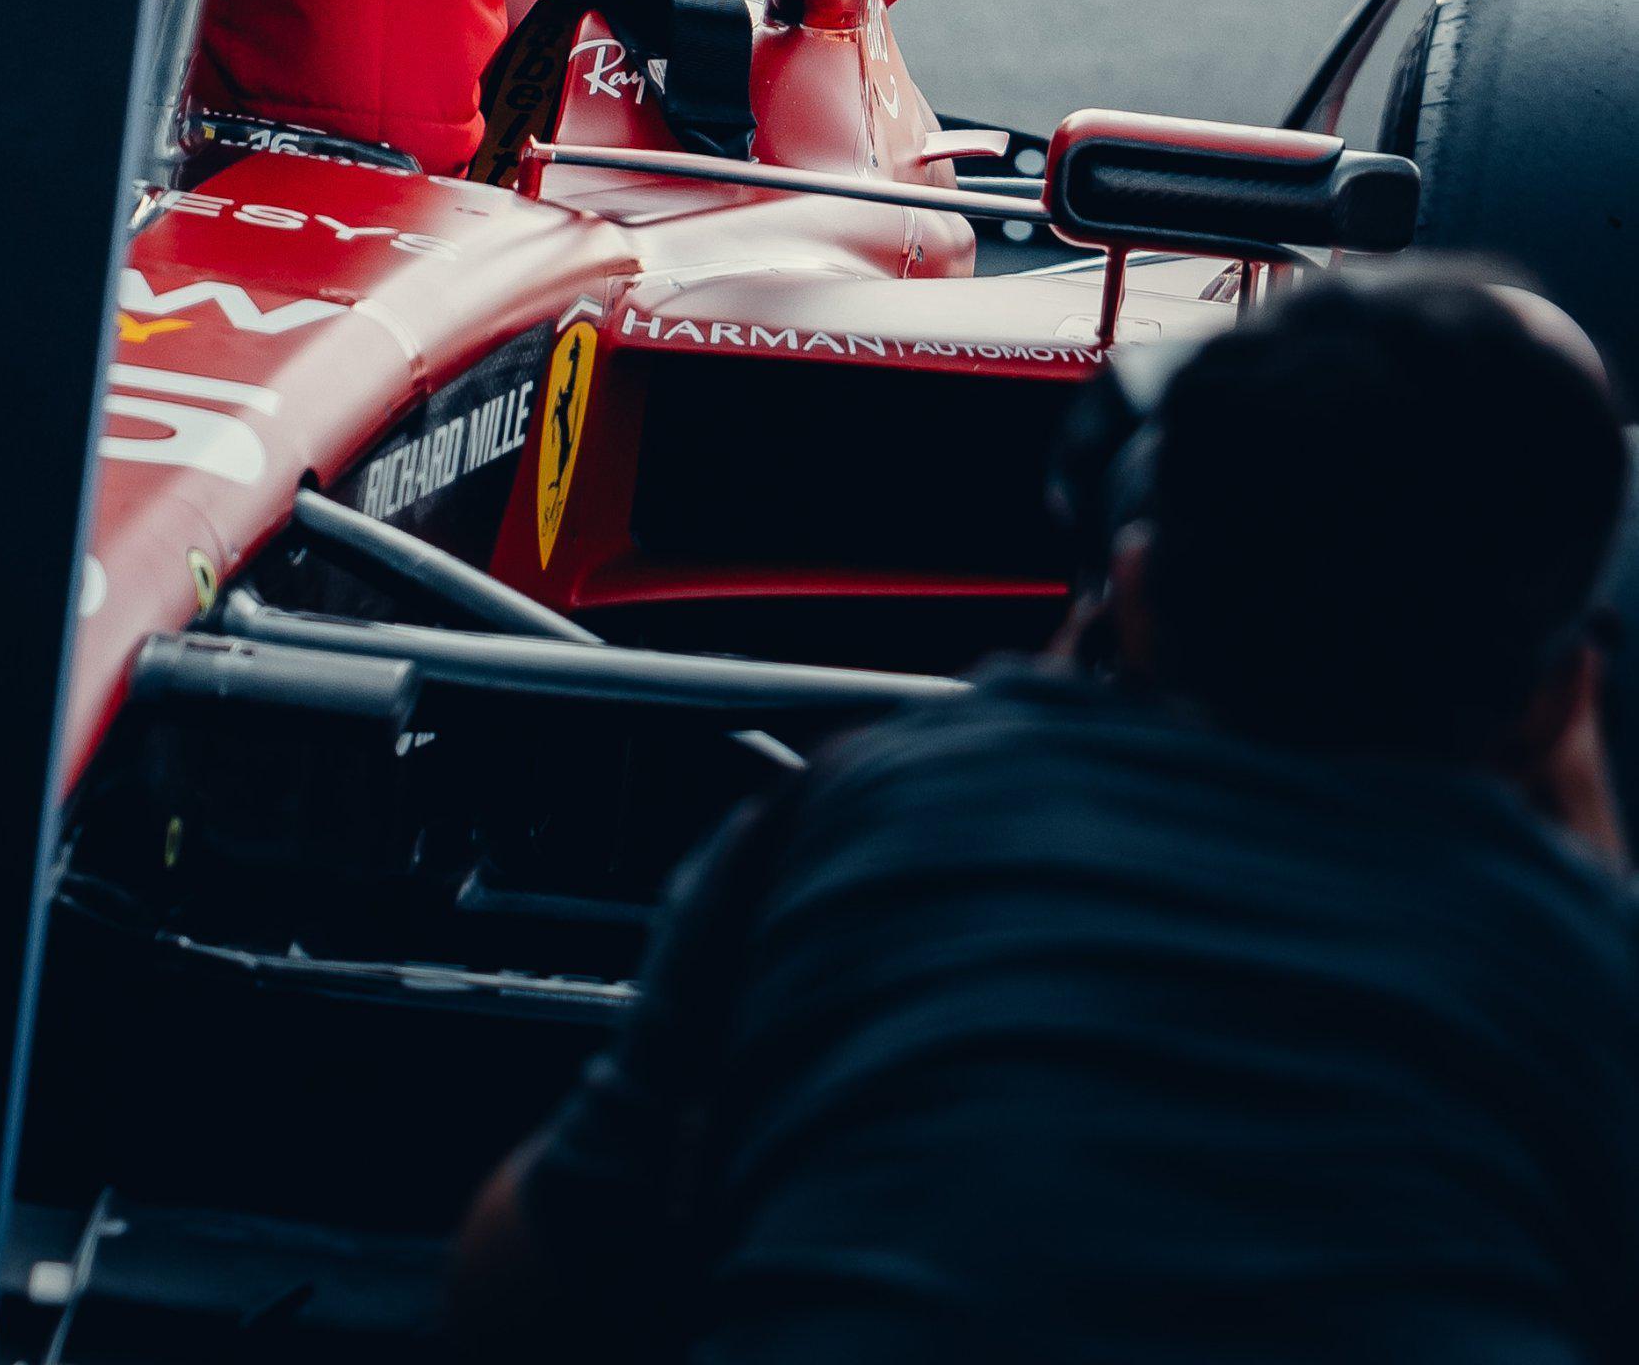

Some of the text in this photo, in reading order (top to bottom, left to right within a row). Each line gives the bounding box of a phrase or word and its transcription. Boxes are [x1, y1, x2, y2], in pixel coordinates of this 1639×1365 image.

[622, 308, 885, 357] HARMAN
[364, 416, 465, 520] RICHARD
[463, 379, 534, 475] MILLE
